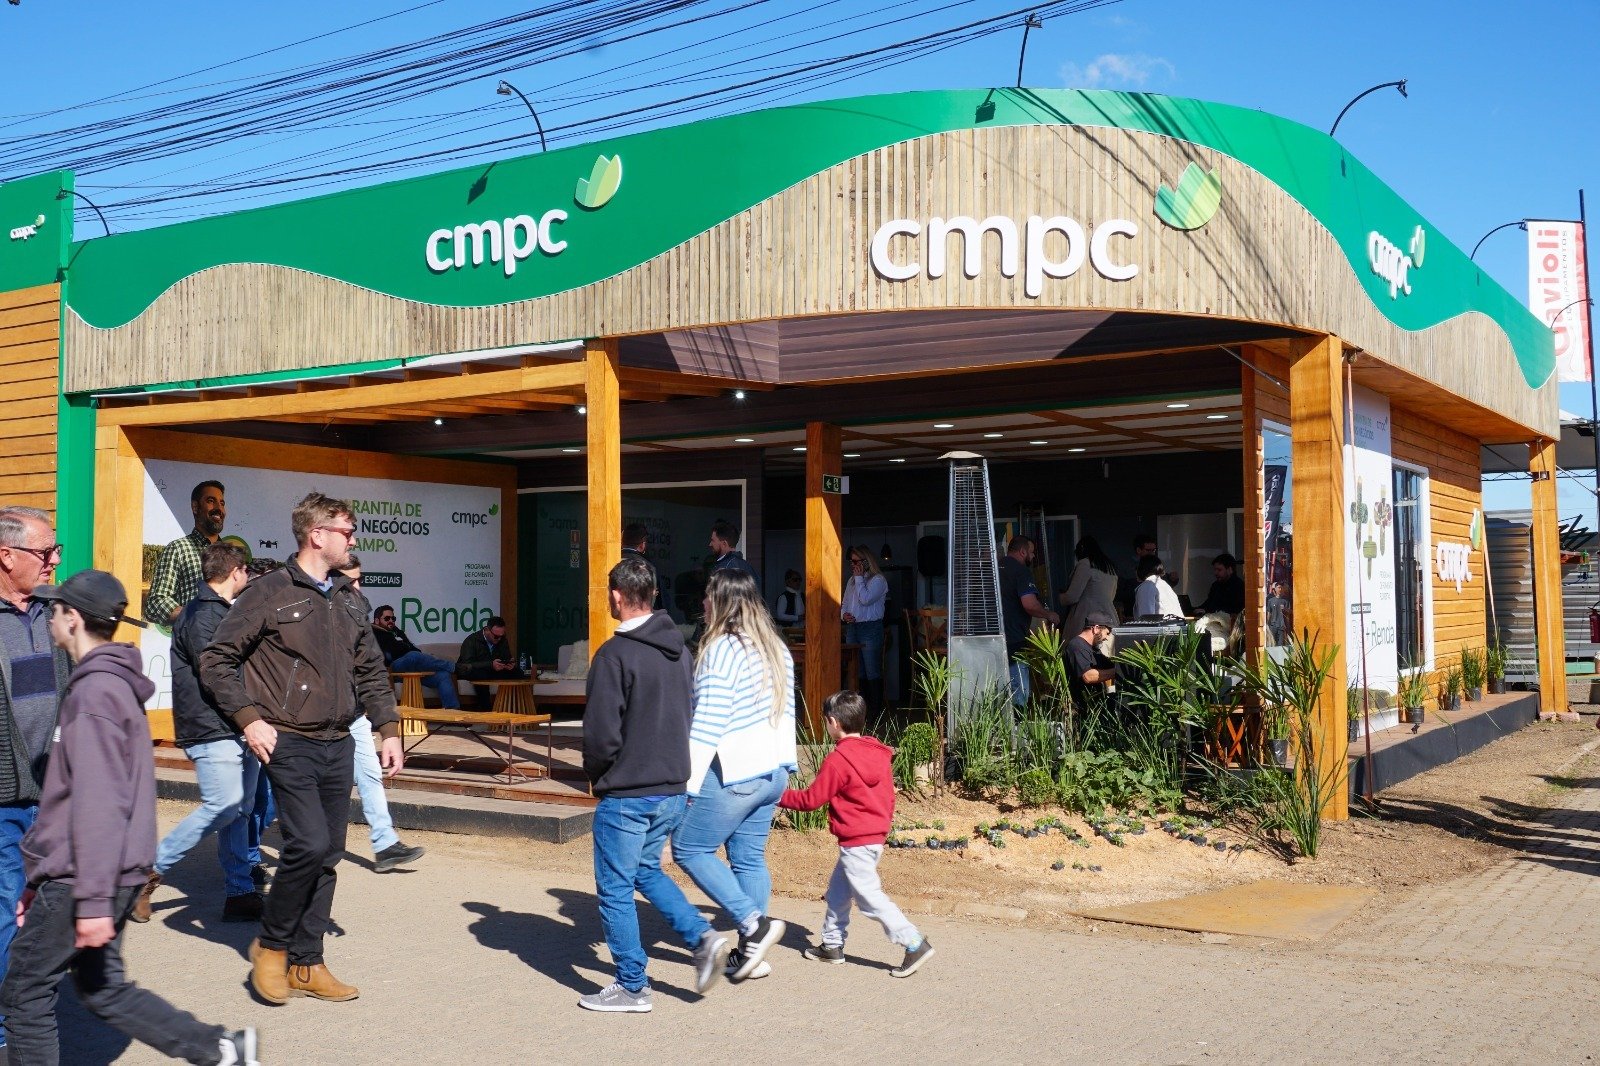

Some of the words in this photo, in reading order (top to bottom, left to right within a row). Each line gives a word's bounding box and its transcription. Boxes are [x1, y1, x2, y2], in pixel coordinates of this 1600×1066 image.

[425, 208, 568, 276] cmpc
[870, 215, 1139, 298] cmpc
[1367, 230, 1413, 300] cmpc
[352, 500, 403, 517] RANTIA
[405, 503, 422, 517] DE
[361, 517, 430, 536] NEGÓCIOS
[451, 511, 488, 528] cmpc
[364, 575, 401, 584] ESPECIAIS
[1436, 541, 1473, 594] cmpc
[401, 597, 495, 634] Renda
